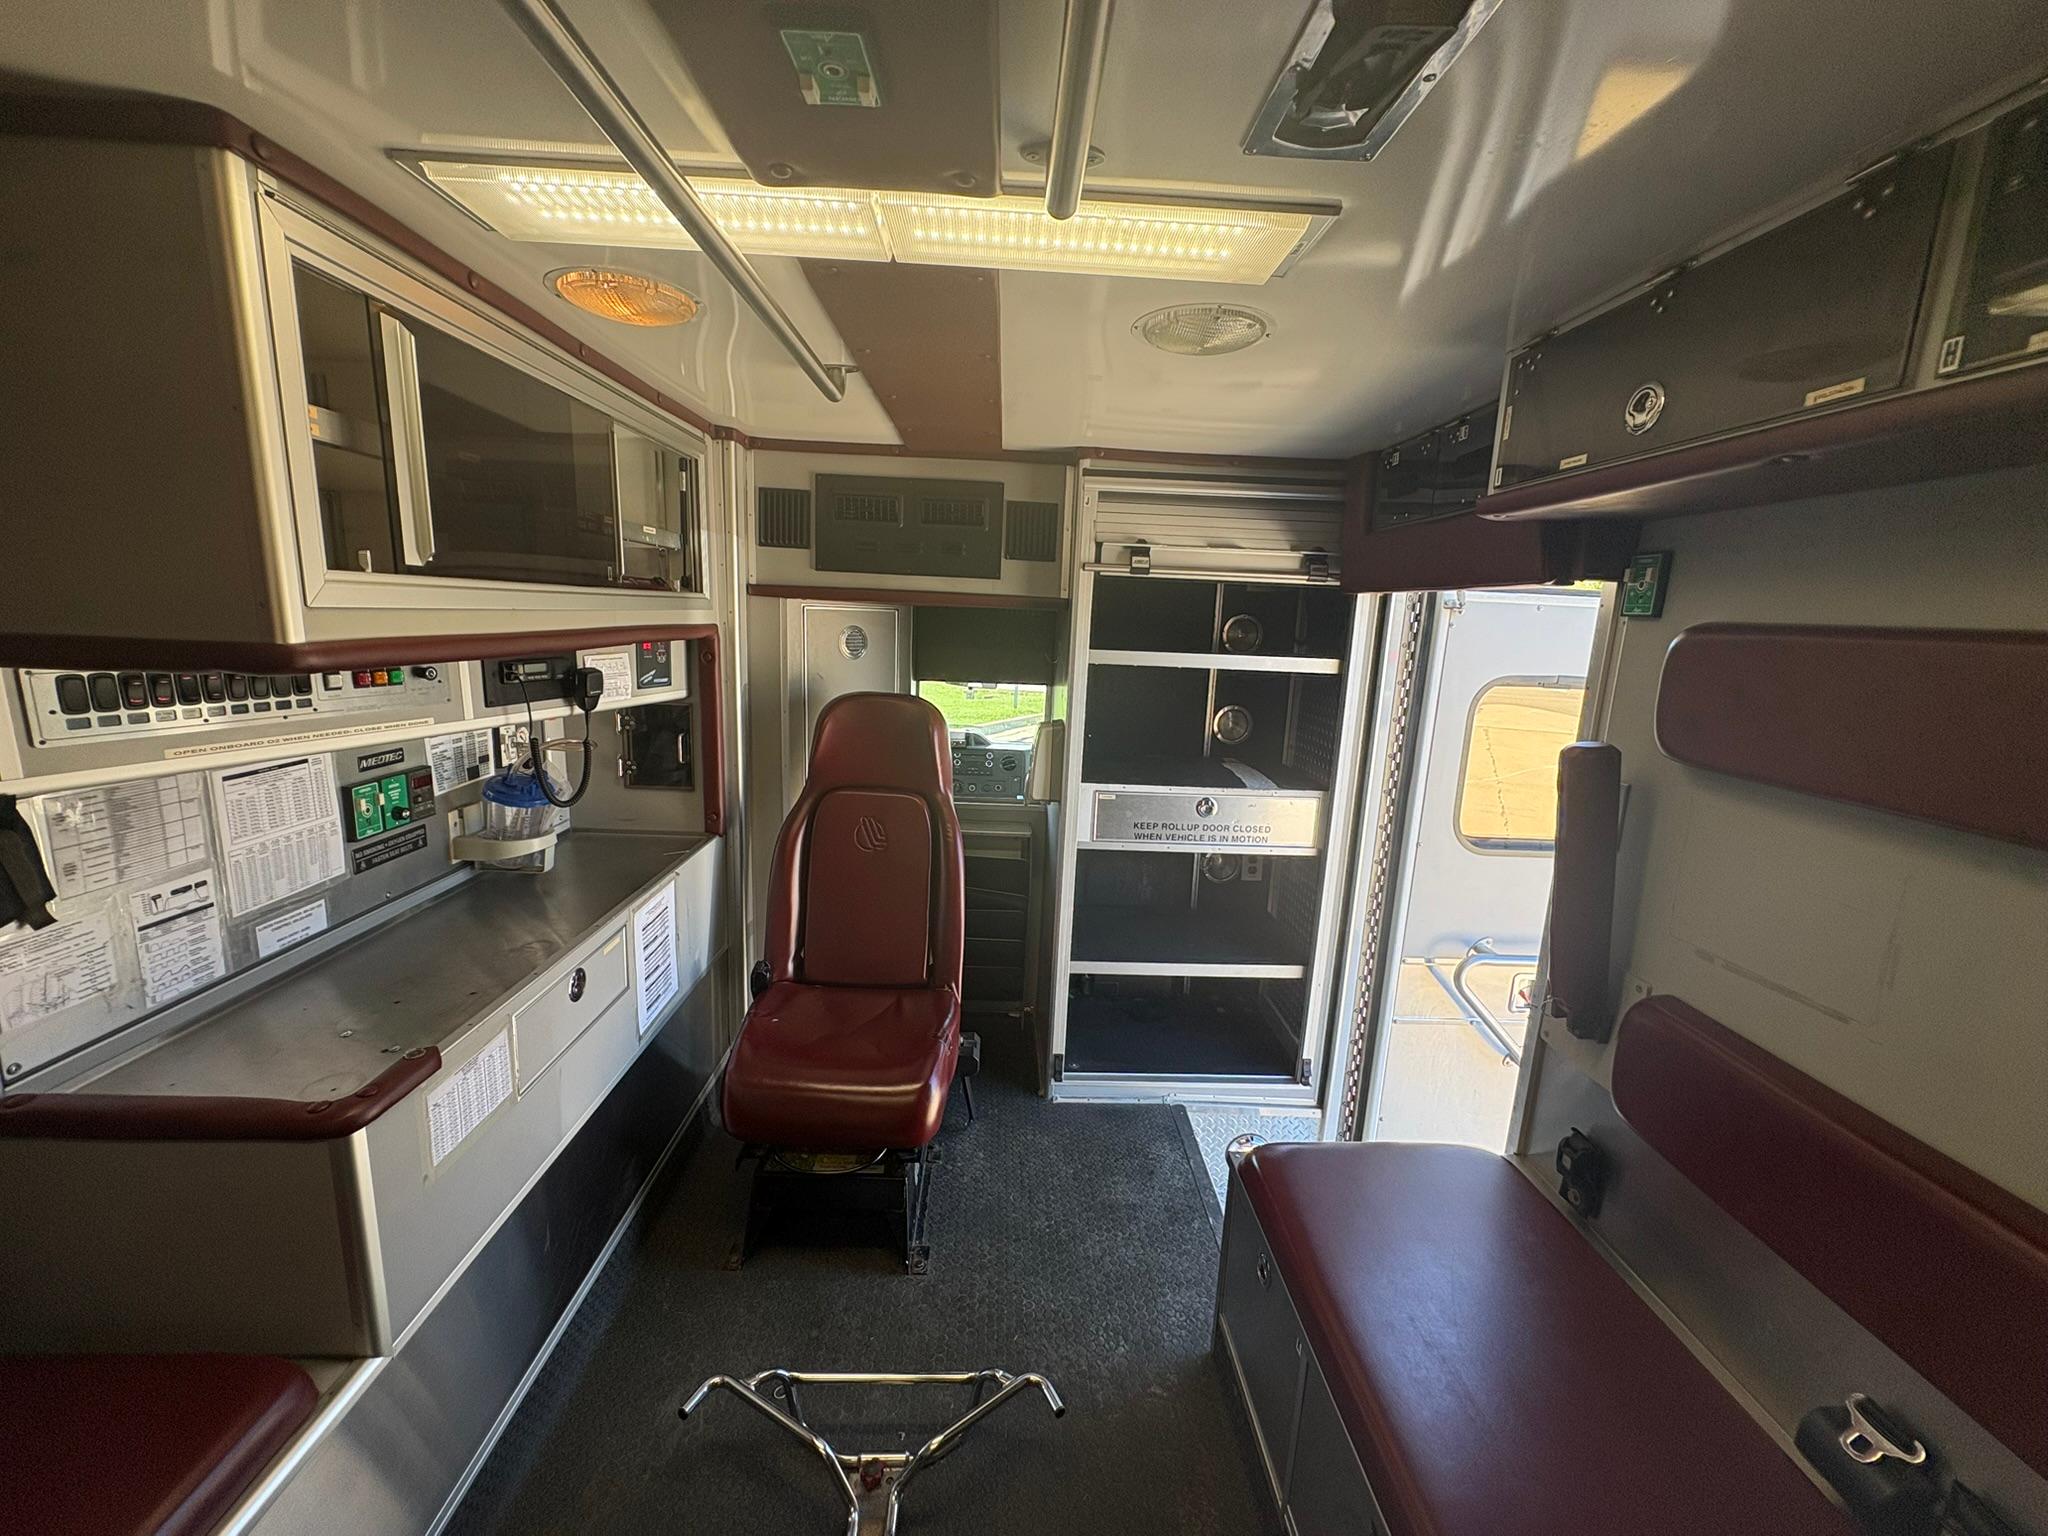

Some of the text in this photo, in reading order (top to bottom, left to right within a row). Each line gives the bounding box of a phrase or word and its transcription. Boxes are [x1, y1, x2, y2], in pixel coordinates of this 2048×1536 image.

[173, 746, 208, 757] OPEN
[210, 740, 264, 752] ONBOARD
[266, 738, 281, 746] O2
[282, 734, 311, 744] WHEN
[353, 725, 383, 734] CLOSE
[384, 721, 407, 730] WHEN
[408, 718, 430, 727] DONE
[359, 750, 403, 769] MEDTEC
[1133, 821, 1272, 834] KEEP ROLLUP DOOR CLOSED
[1133, 832, 1270, 844] WHEN VEHICLE IS IN MOTION
